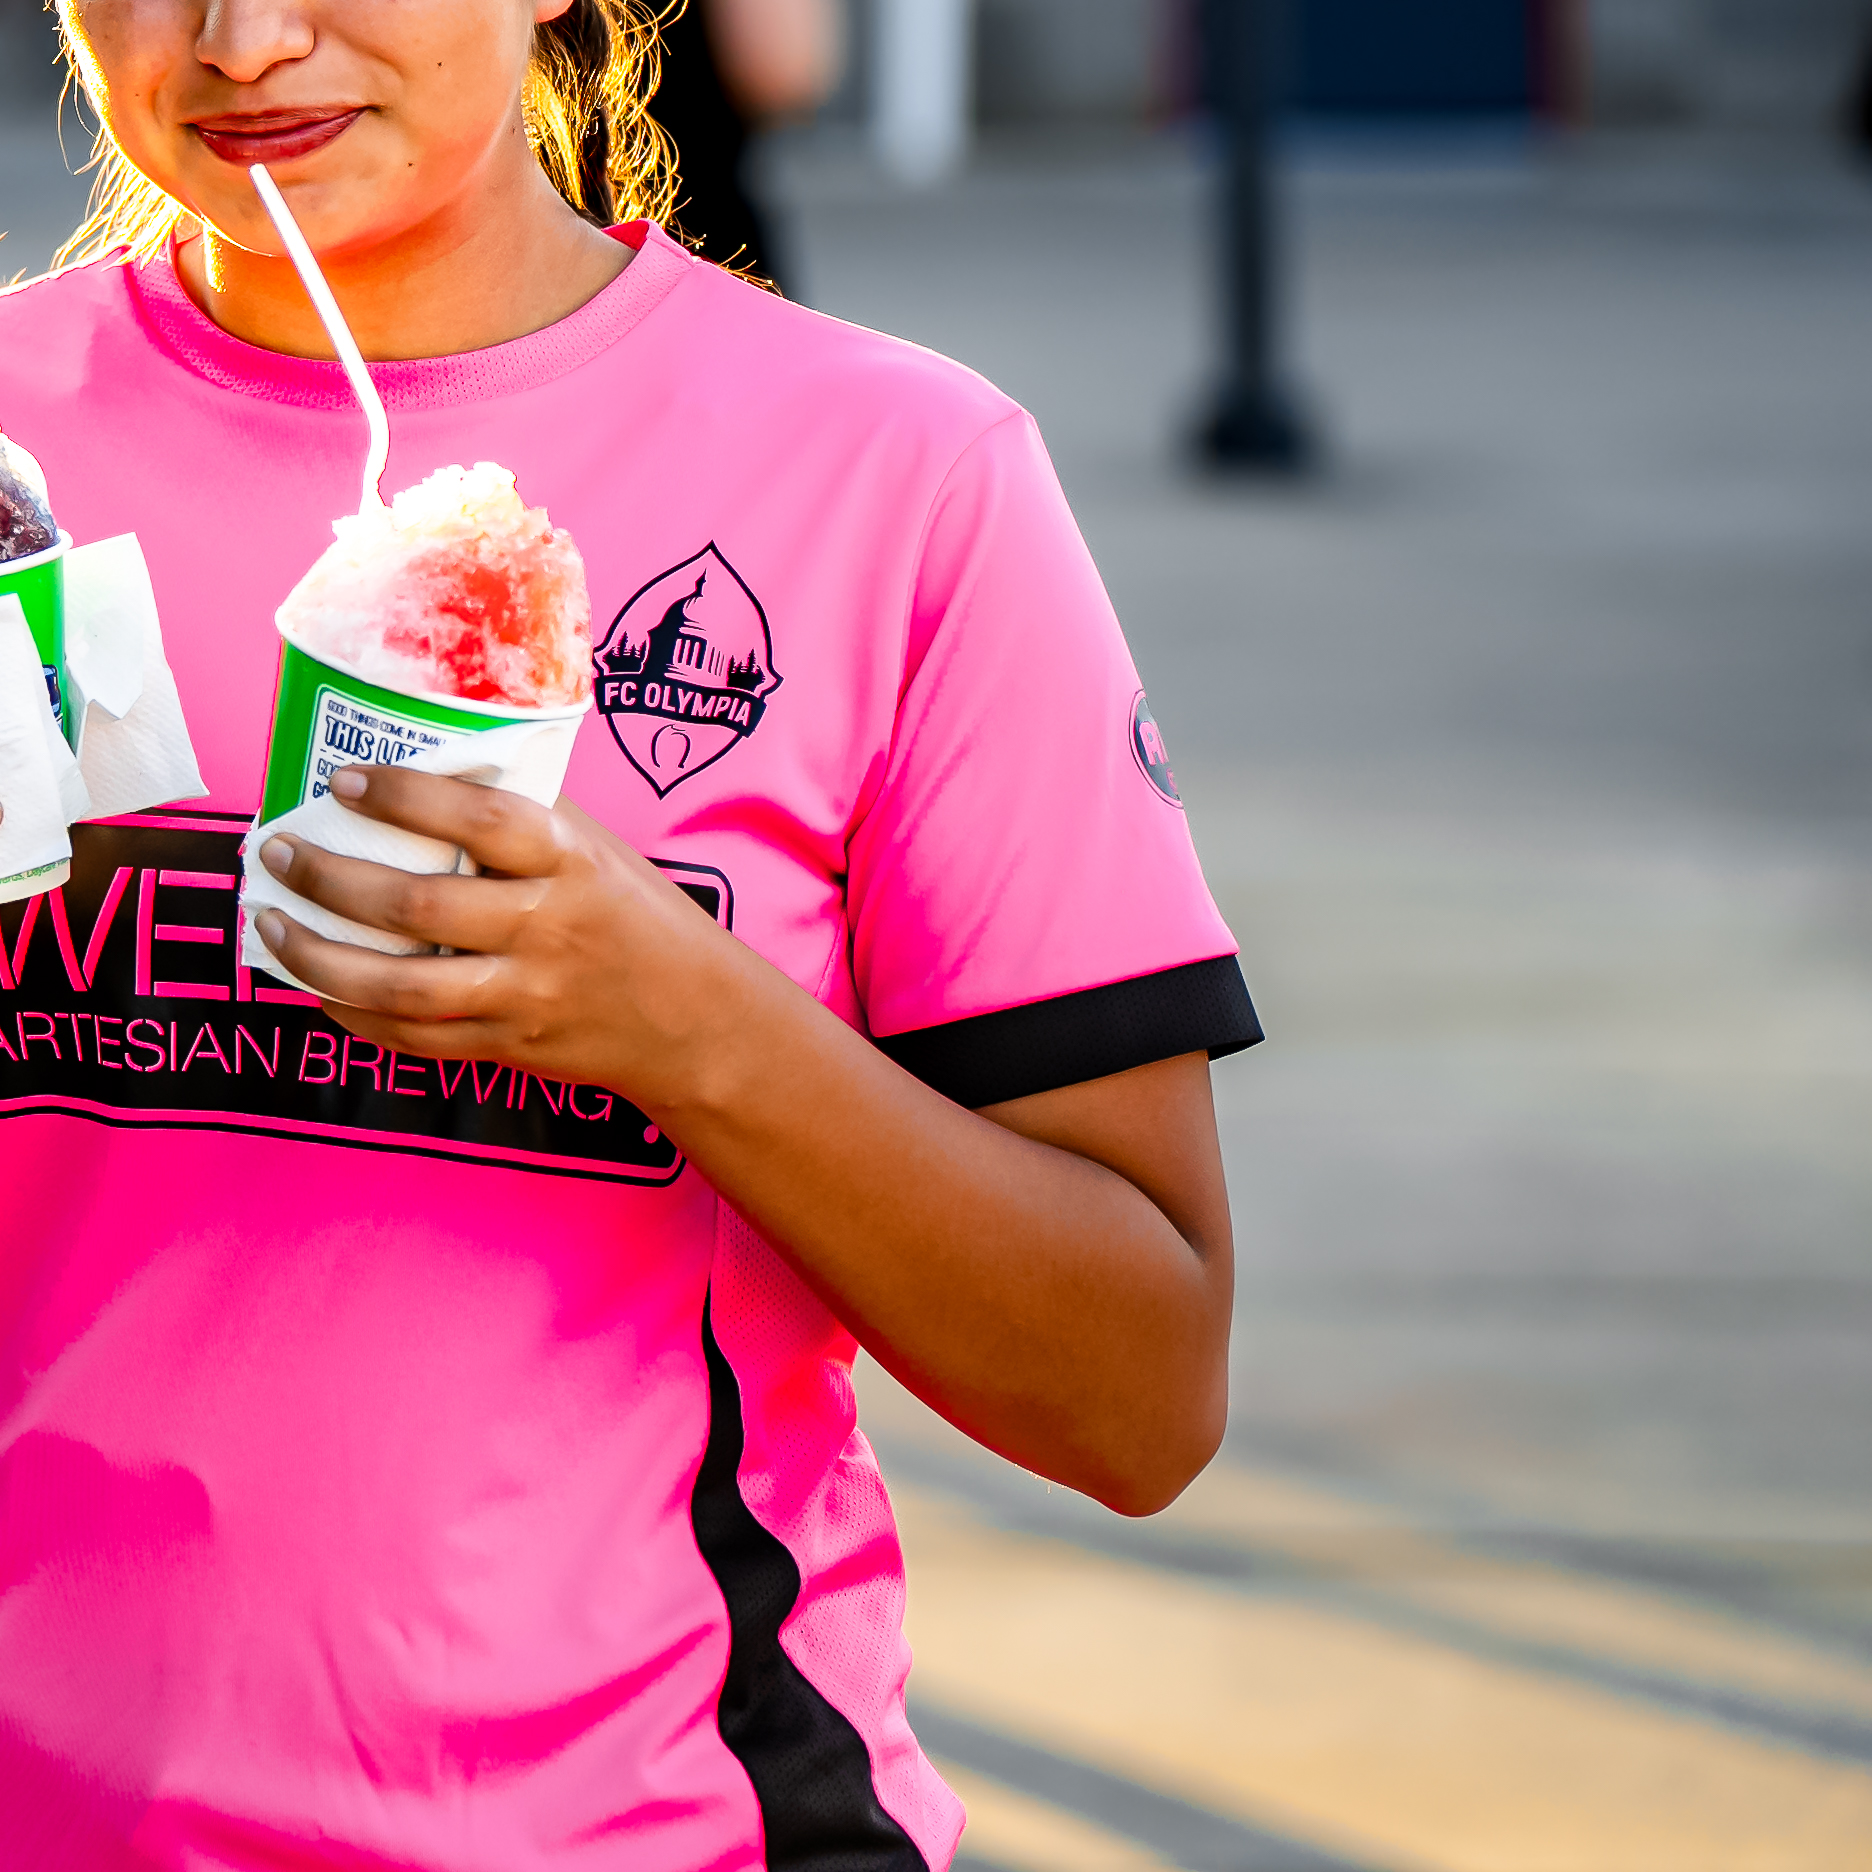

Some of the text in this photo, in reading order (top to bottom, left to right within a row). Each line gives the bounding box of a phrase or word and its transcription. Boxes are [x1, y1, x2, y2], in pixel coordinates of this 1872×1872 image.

[604, 681, 752, 727] FC OLYMPIA
[325, 714, 375, 761] THIS
[298, 1031, 613, 1121] BREWING
